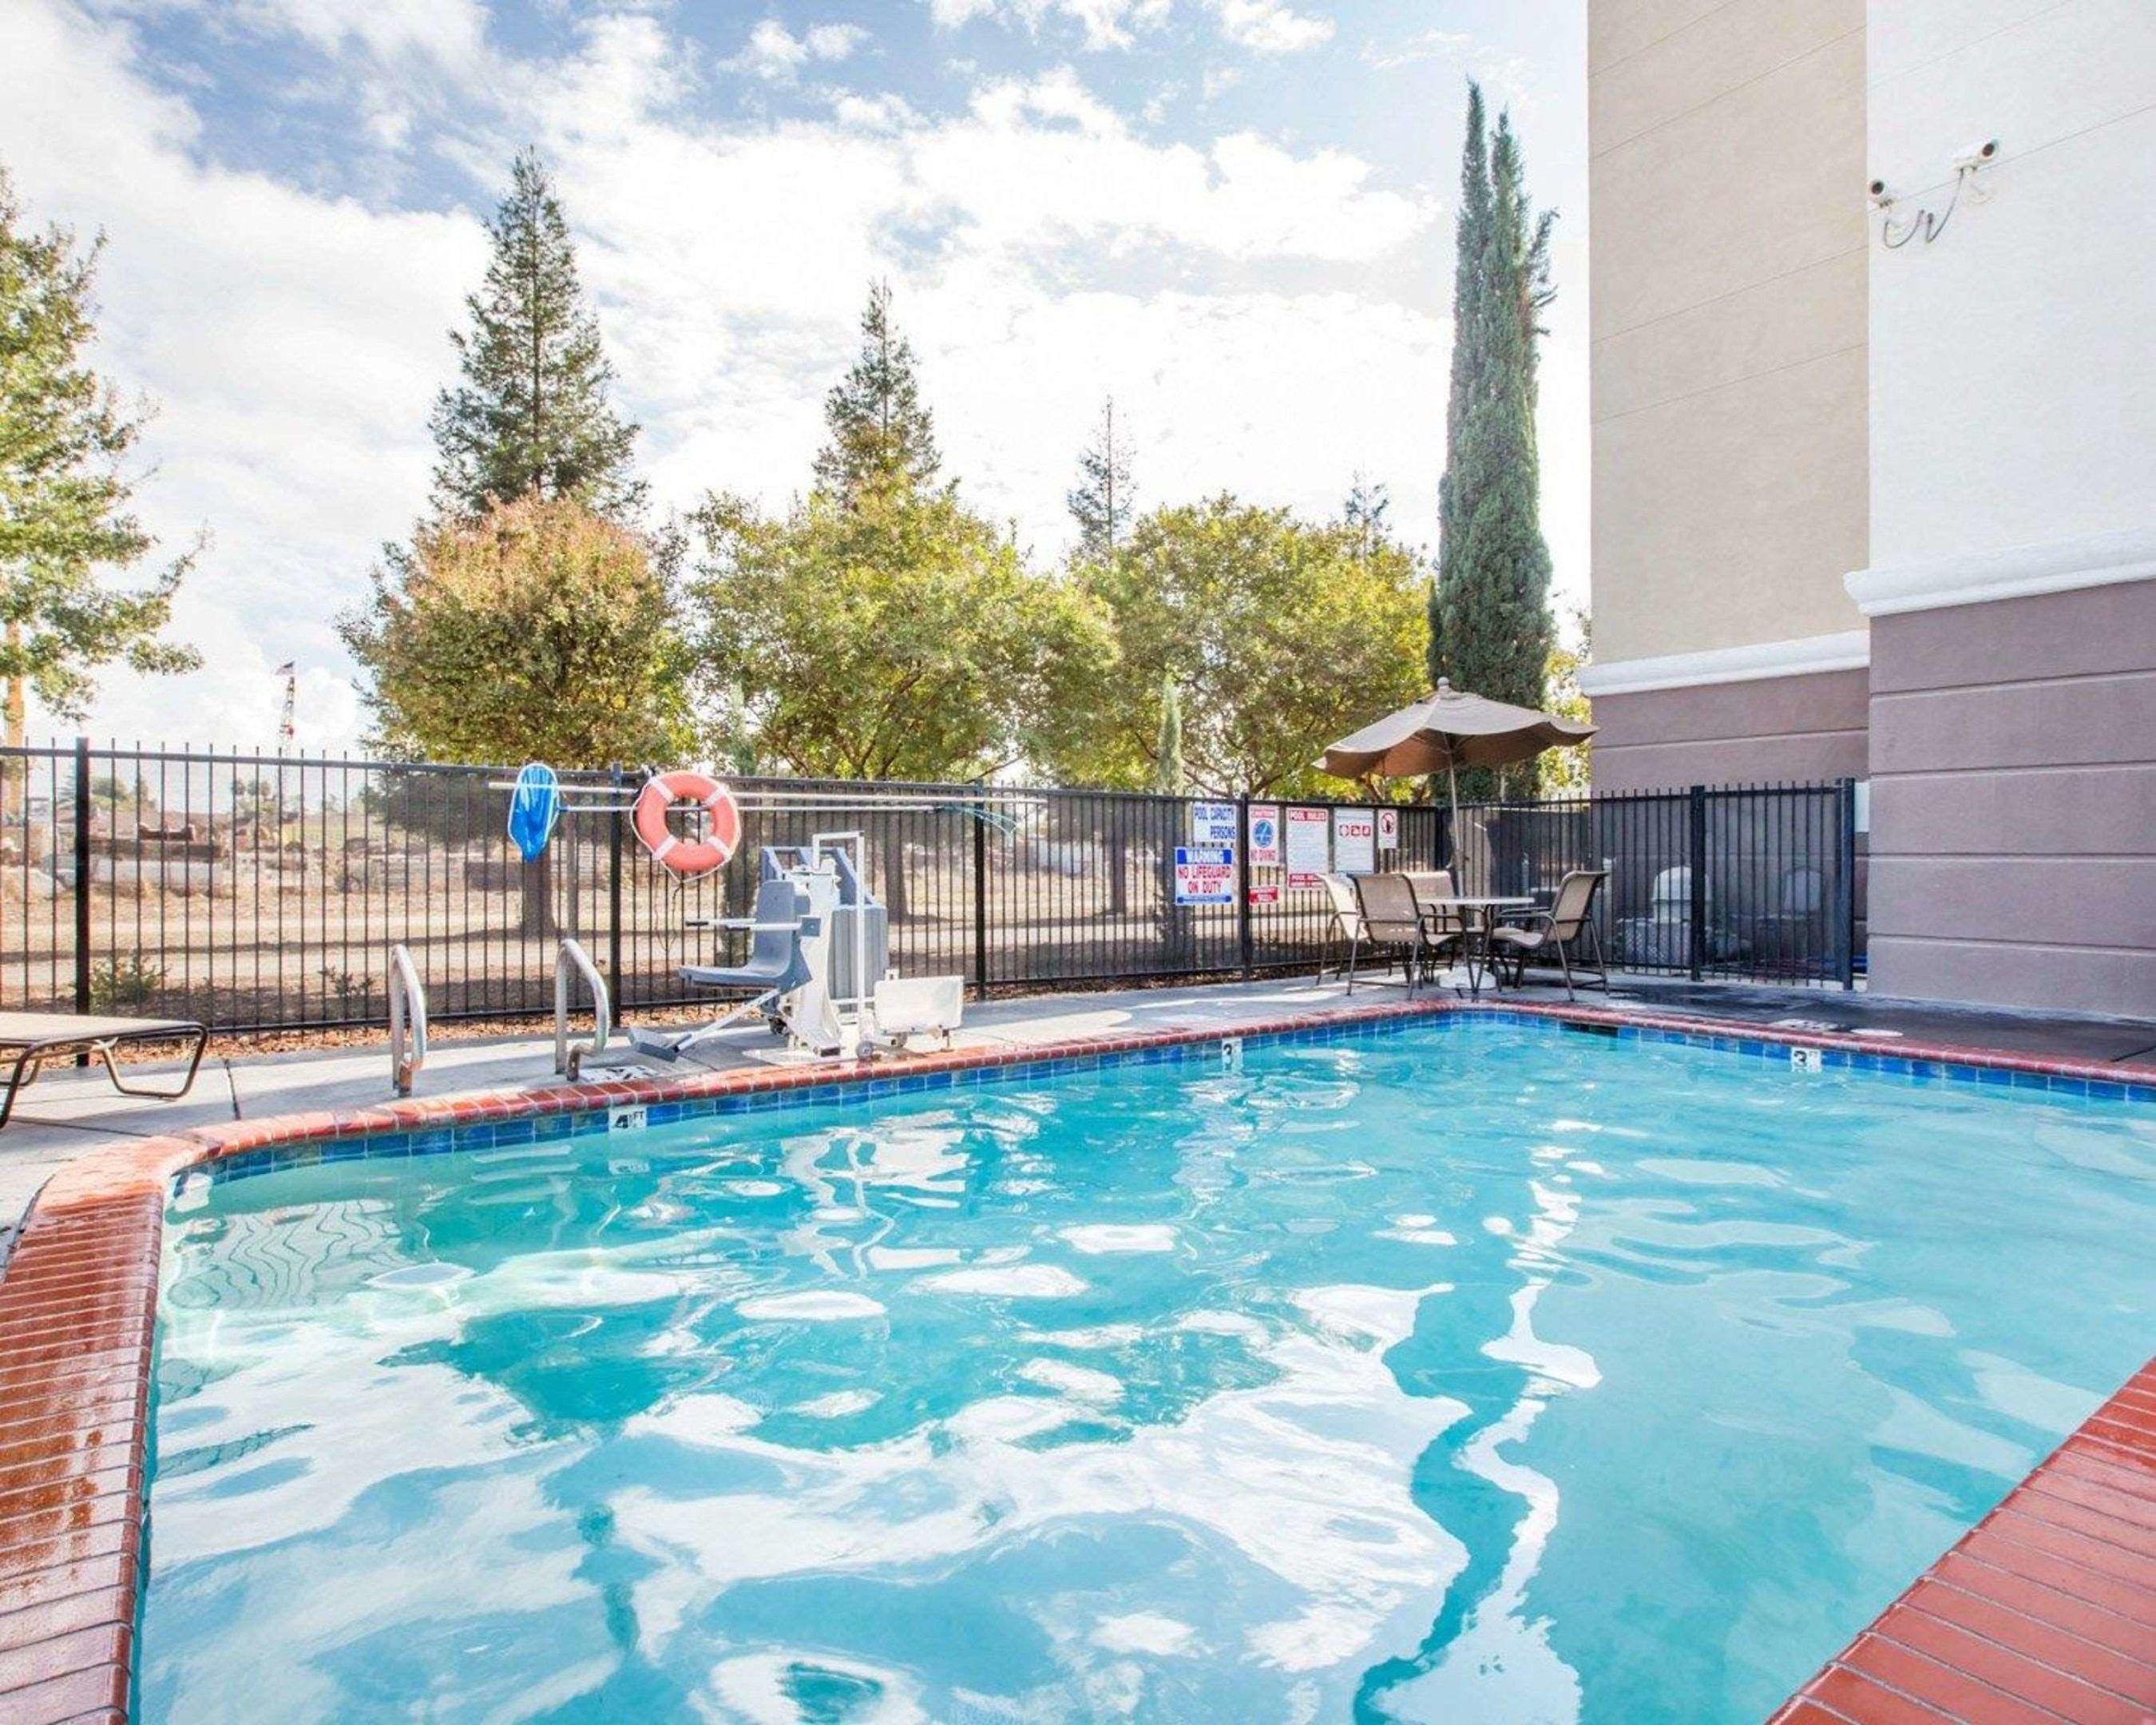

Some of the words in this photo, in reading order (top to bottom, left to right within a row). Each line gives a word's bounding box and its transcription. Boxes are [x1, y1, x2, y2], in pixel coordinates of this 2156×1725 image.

[1185, 850, 1223, 863] WARNING
[1178, 866, 1188, 879] NO
[1192, 866, 1231, 878] LIFEGUARD
[1188, 880, 1199, 894] ON
[1203, 880, 1223, 894] DUTY
[615, 1114, 628, 1128] 4
